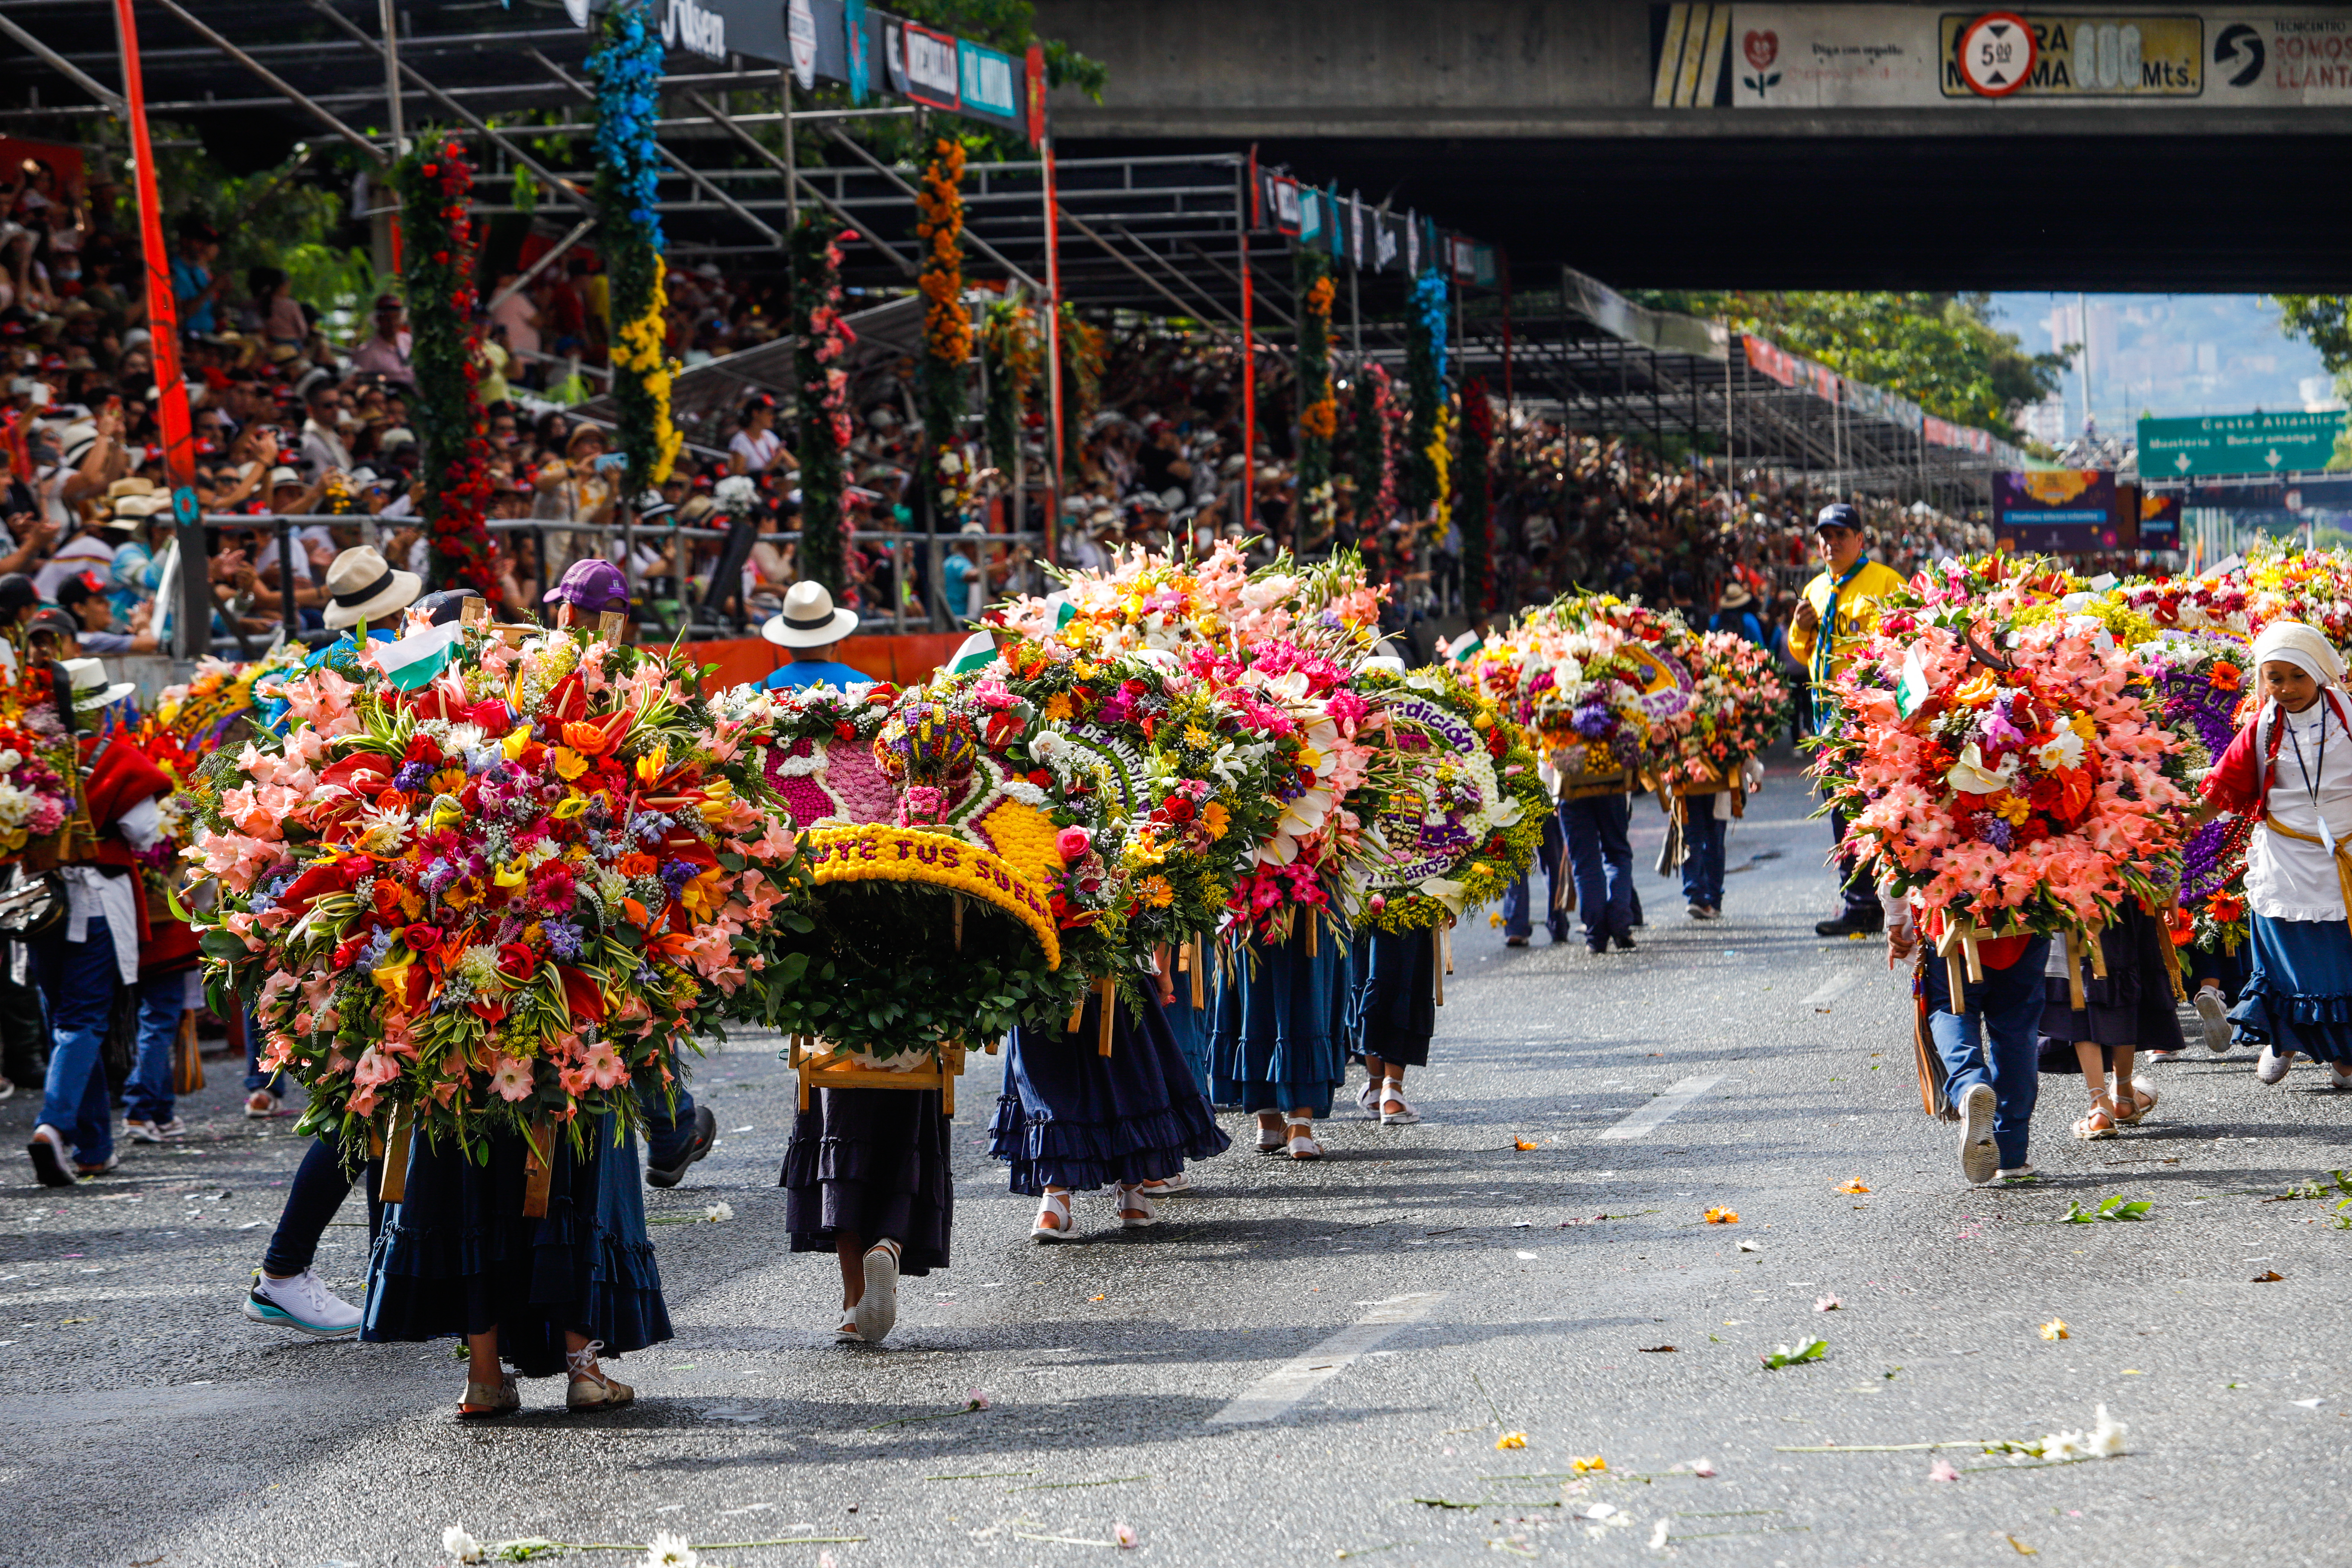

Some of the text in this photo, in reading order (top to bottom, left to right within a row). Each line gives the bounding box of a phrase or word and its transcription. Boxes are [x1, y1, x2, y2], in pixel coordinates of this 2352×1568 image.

[2201, 418, 2255, 431] Costa
[1078, 723, 1107, 744] DE
[1107, 737, 1151, 804] NUESTRA
[895, 841, 960, 868] TUS
